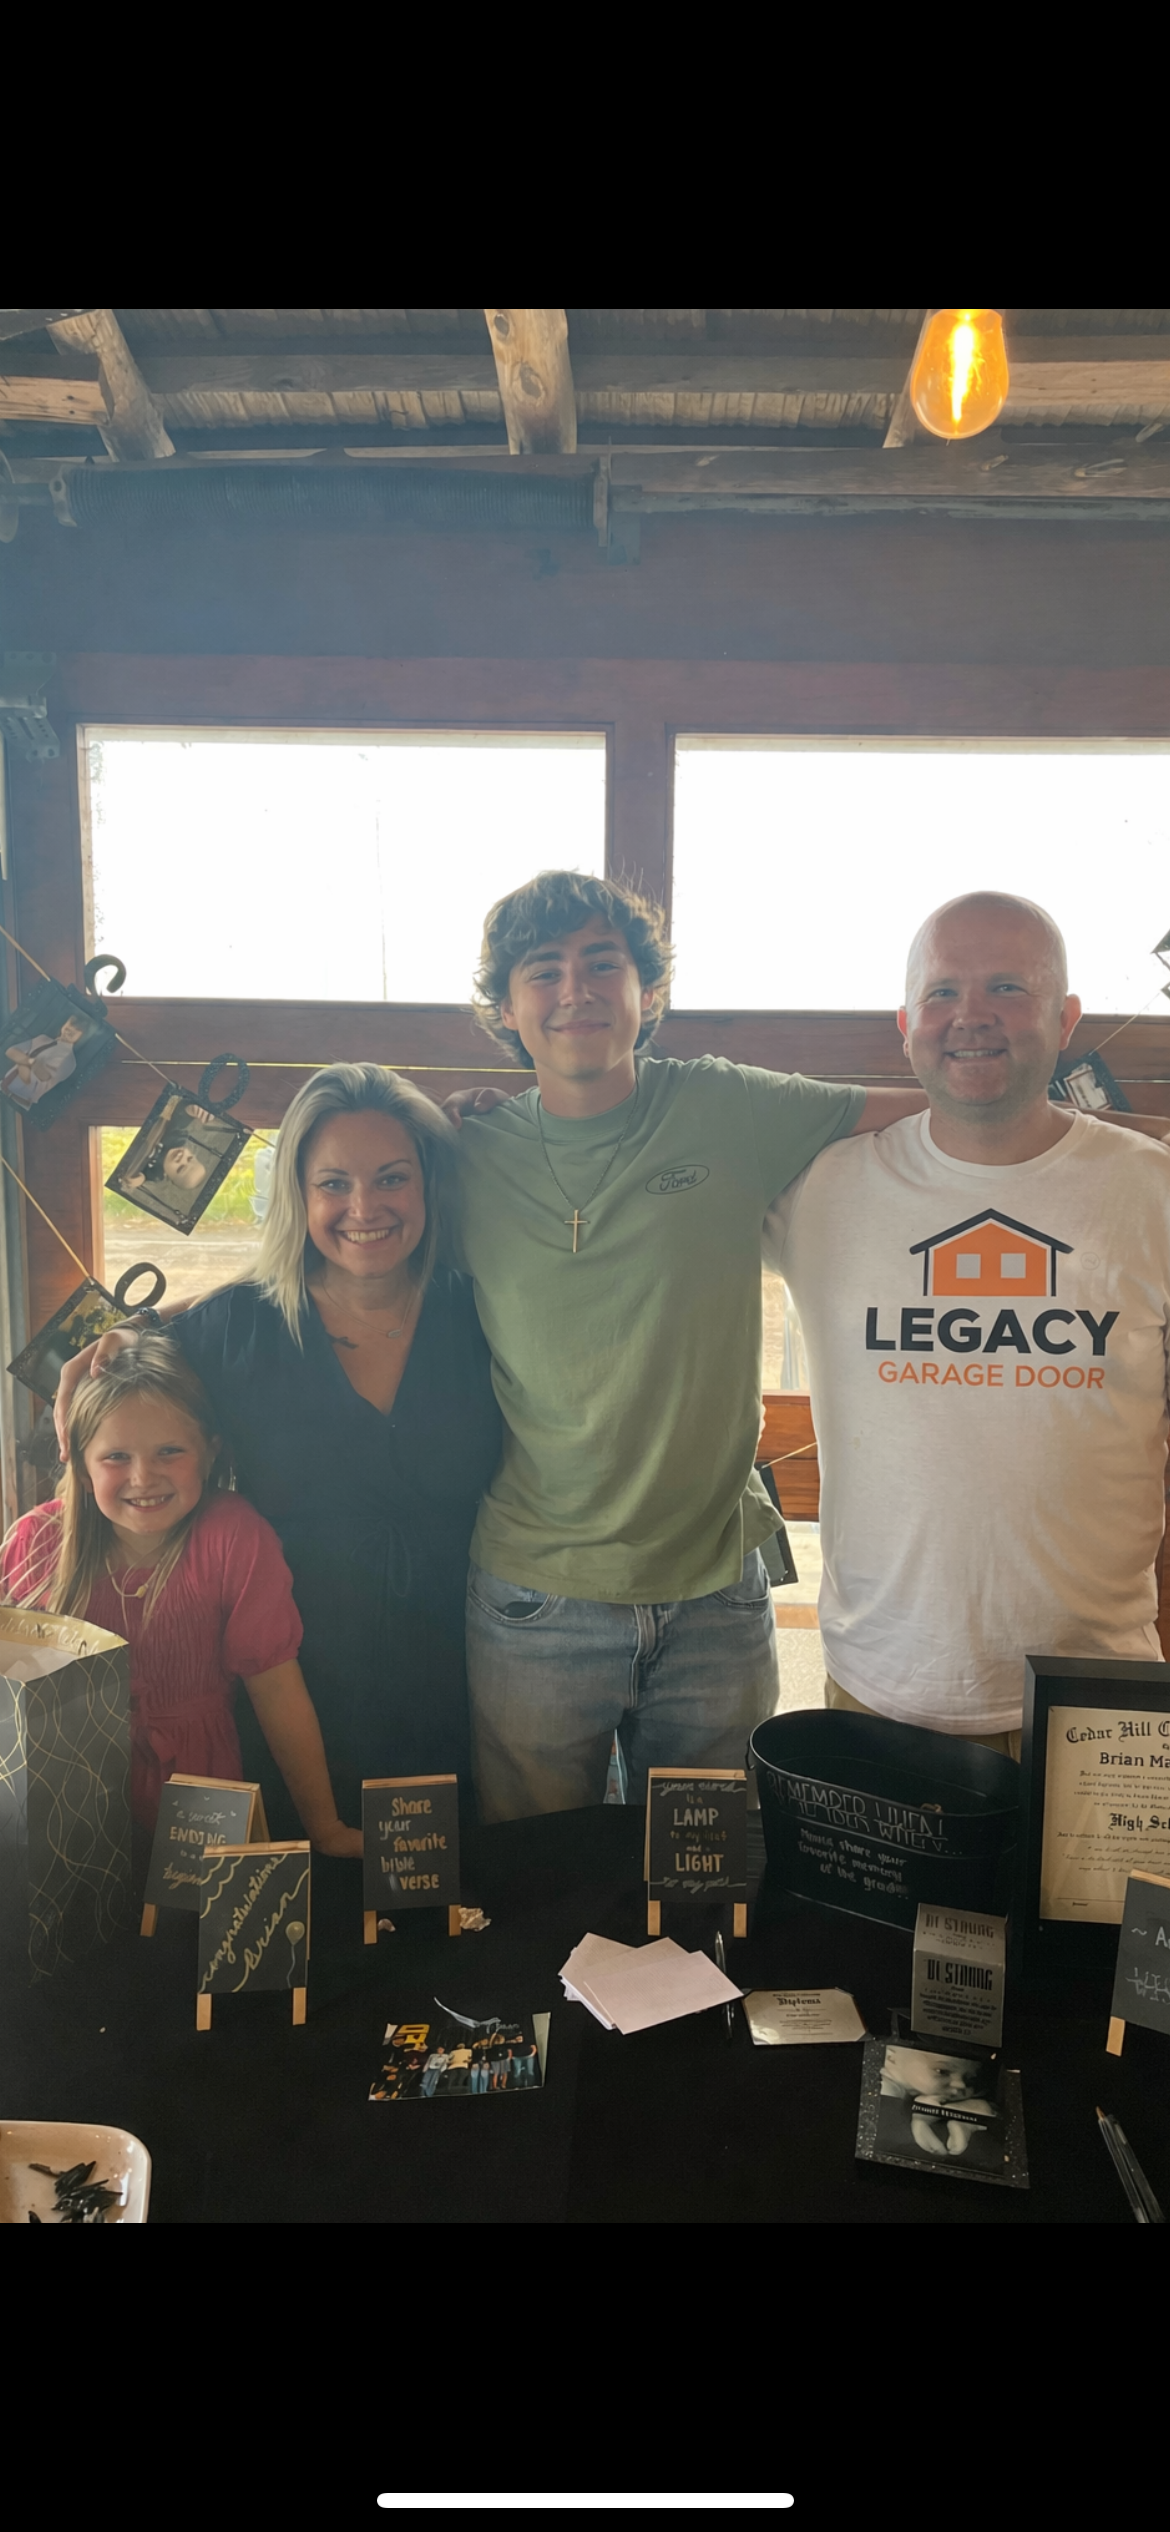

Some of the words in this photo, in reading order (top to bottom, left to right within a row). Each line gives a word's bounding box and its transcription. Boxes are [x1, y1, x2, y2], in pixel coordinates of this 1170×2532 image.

[866, 1306, 1121, 1356] LEGACY
[877, 1360, 1004, 1387] GARAGE
[1015, 1365, 1105, 1389] DOOR
[1118, 1721, 1152, 1742] Hill
[1099, 1752, 1144, 1767] Brian
[391, 1796, 432, 1817] Share
[673, 1807, 719, 1827] LAMP
[1108, 1812, 1143, 1832] High
[393, 1832, 448, 1852] favorite
[380, 1856, 415, 1873] bible
[675, 1852, 724, 1873] LIGHT
[399, 1873, 440, 1890] verse
